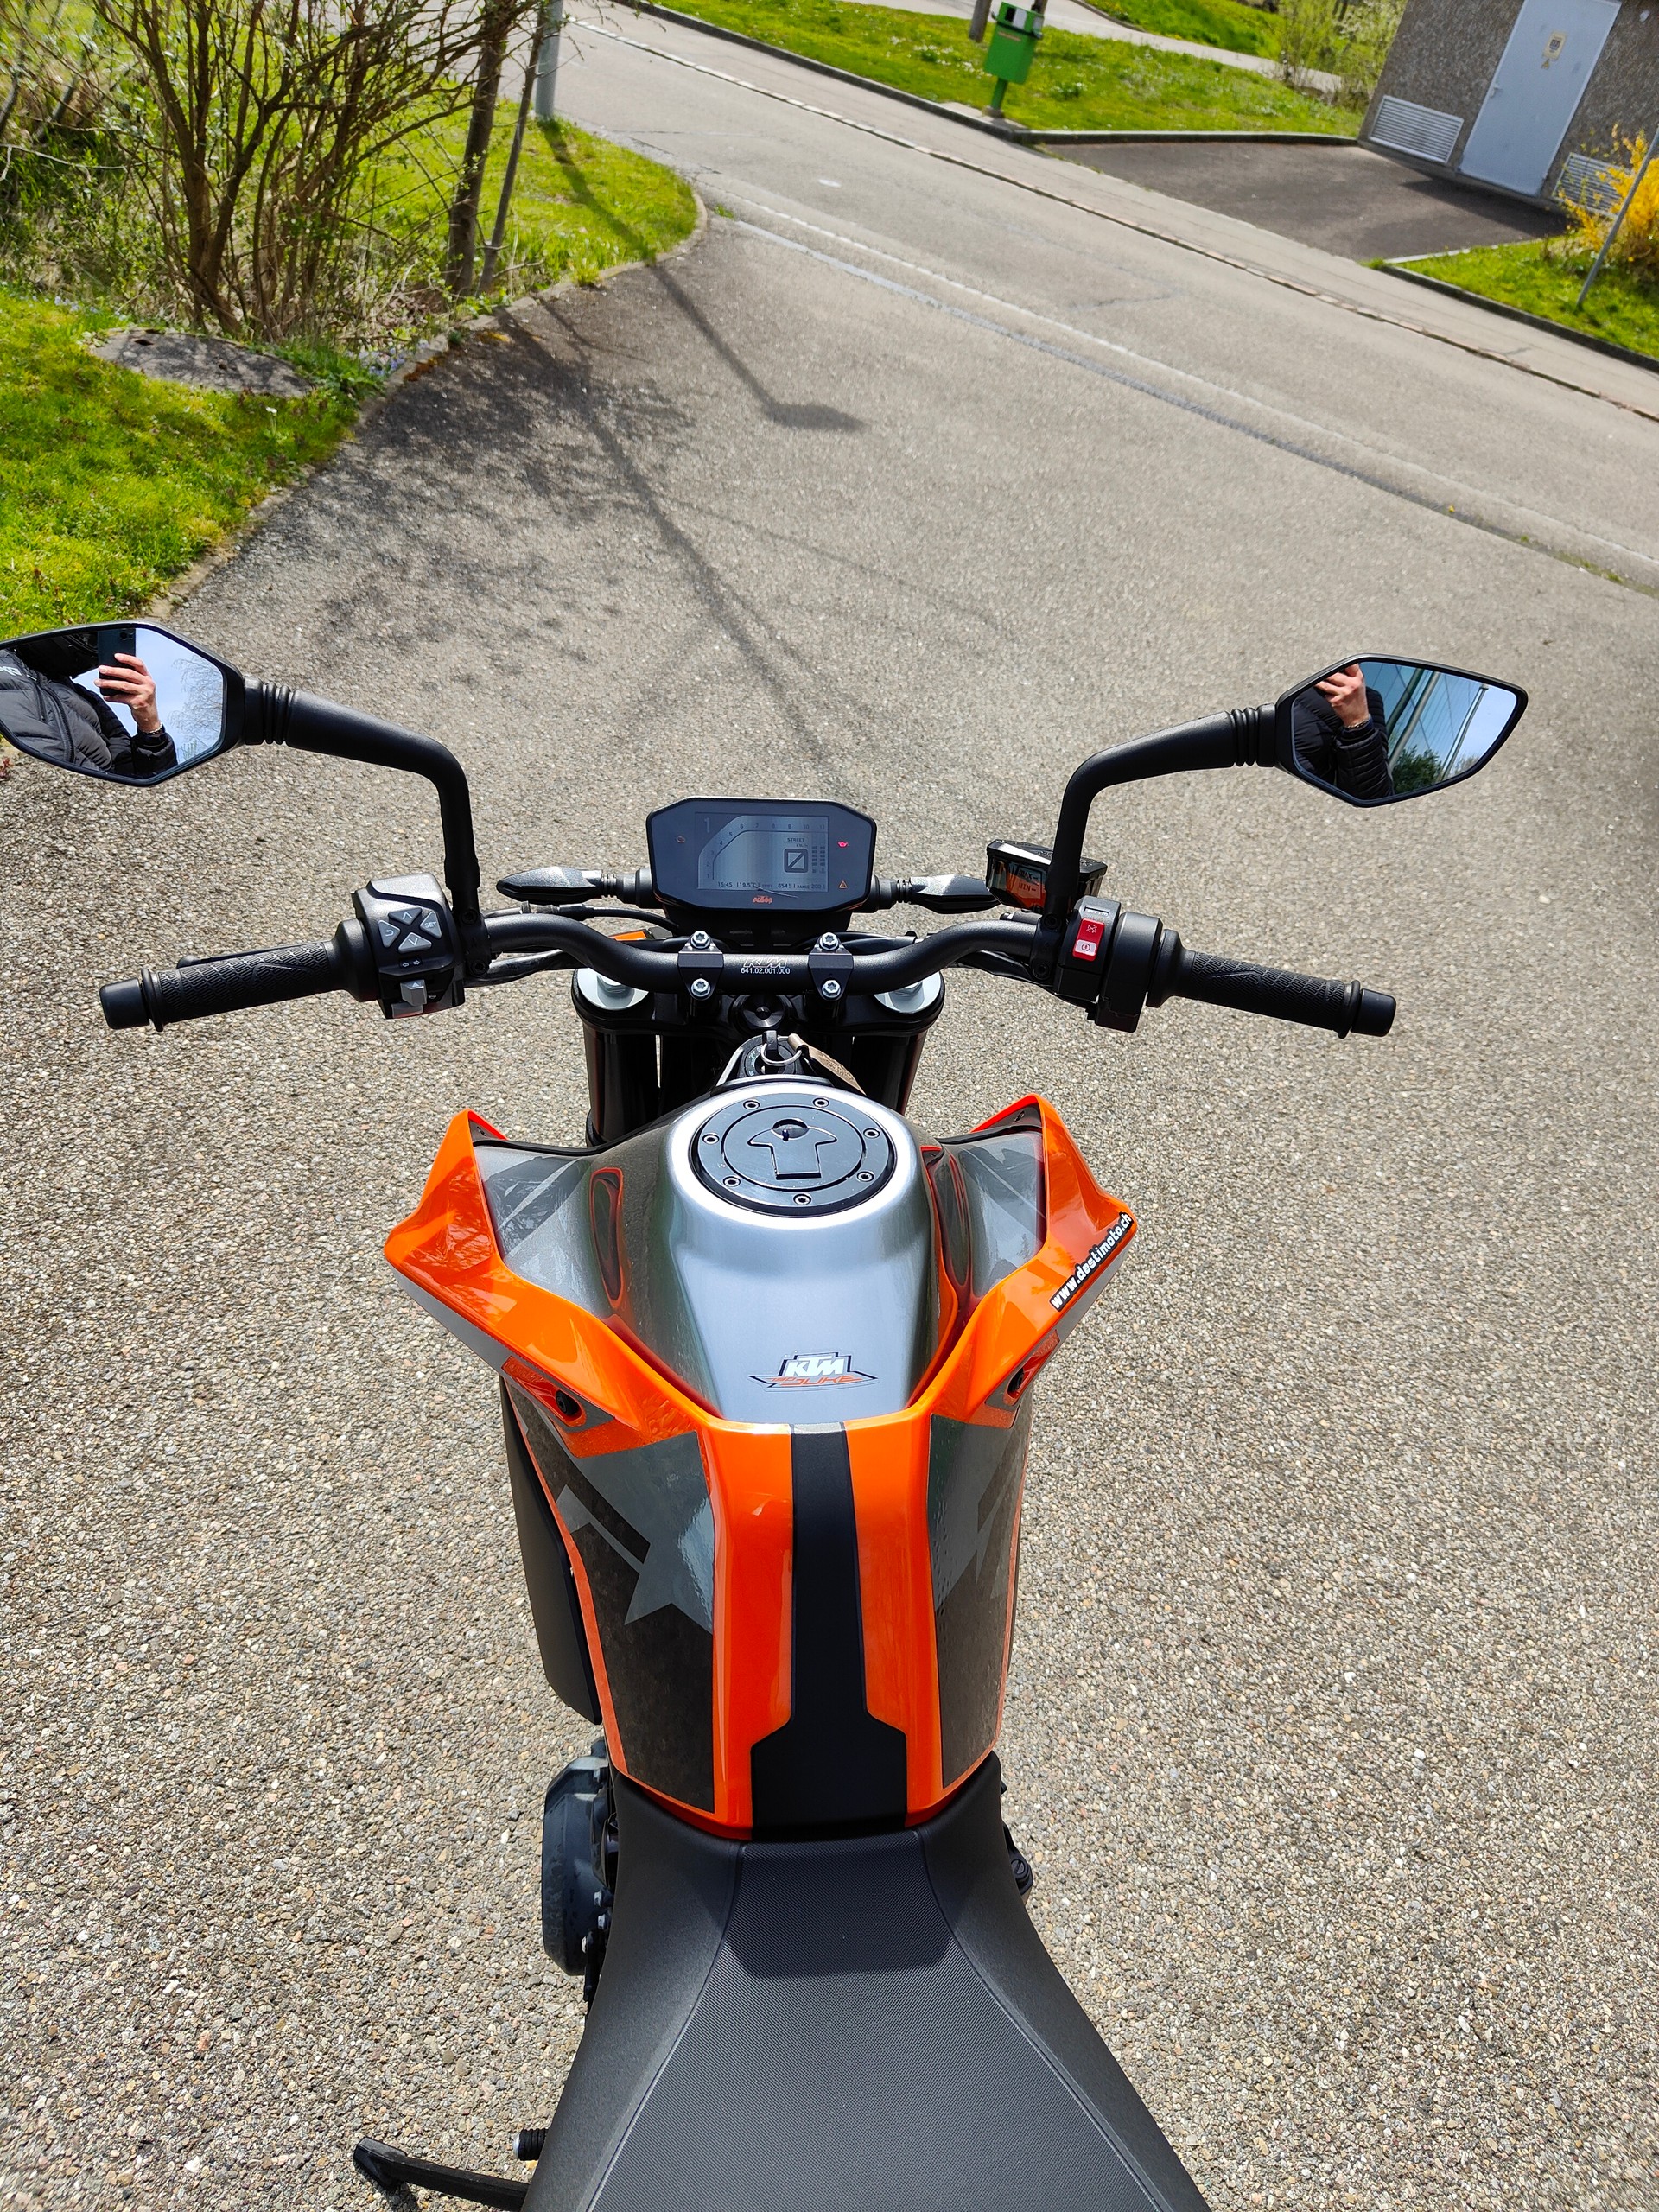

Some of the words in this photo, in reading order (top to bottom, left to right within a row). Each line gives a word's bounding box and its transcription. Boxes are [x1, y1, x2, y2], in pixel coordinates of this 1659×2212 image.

[743, 956, 787, 969] KTM
[1051, 1213, 1133, 1309] www.destimoto.ch
[784, 1355, 845, 1377] KTM
[780, 1375, 863, 1387] DUKE
